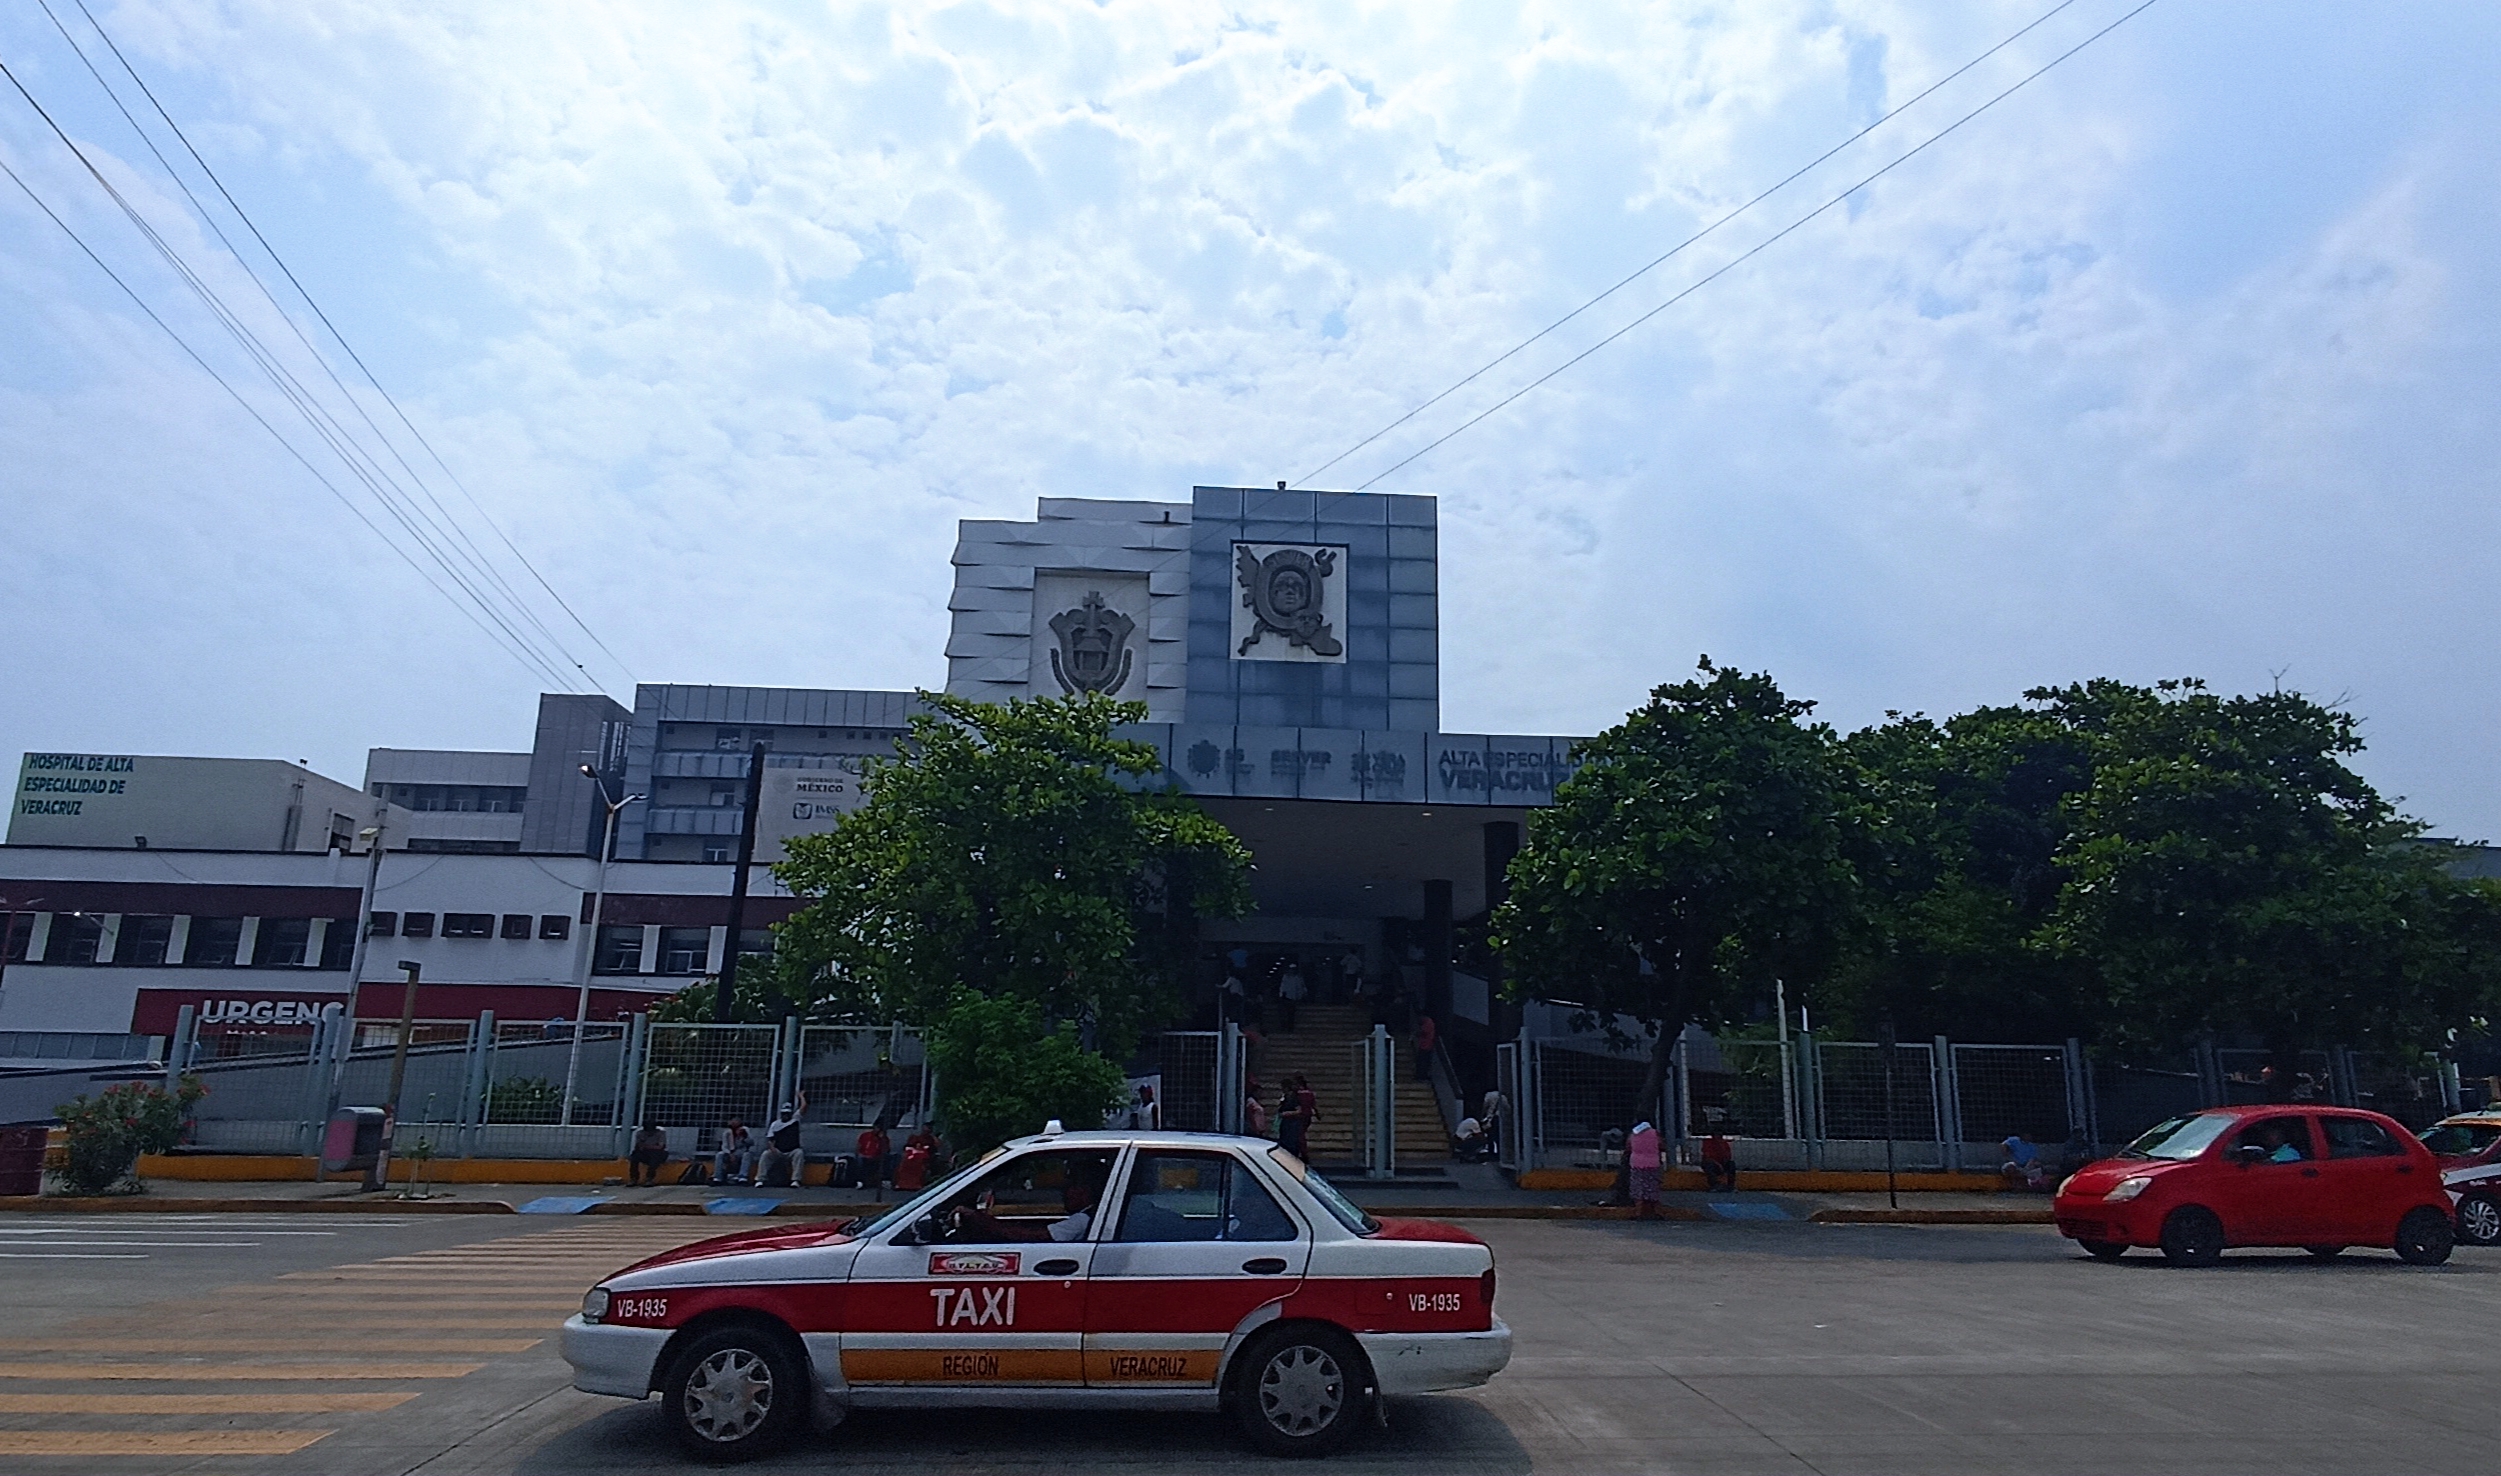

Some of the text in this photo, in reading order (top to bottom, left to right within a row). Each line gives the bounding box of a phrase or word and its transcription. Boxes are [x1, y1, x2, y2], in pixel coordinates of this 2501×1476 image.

[29, 755, 134, 772] HOSPITAL DE ALTA
[1439, 750, 1481, 767] ALTA
[24, 777, 126, 794] ESPECIALIDAD DE
[21, 799, 83, 815] VERACRUZ
[617, 1298, 668, 1318] VB-1935
[930, 1287, 1016, 1327] TAXI
[1408, 1293, 1461, 1311] VB-1935
[942, 1352, 1187, 1377] REGIÓN VERACRUZ
